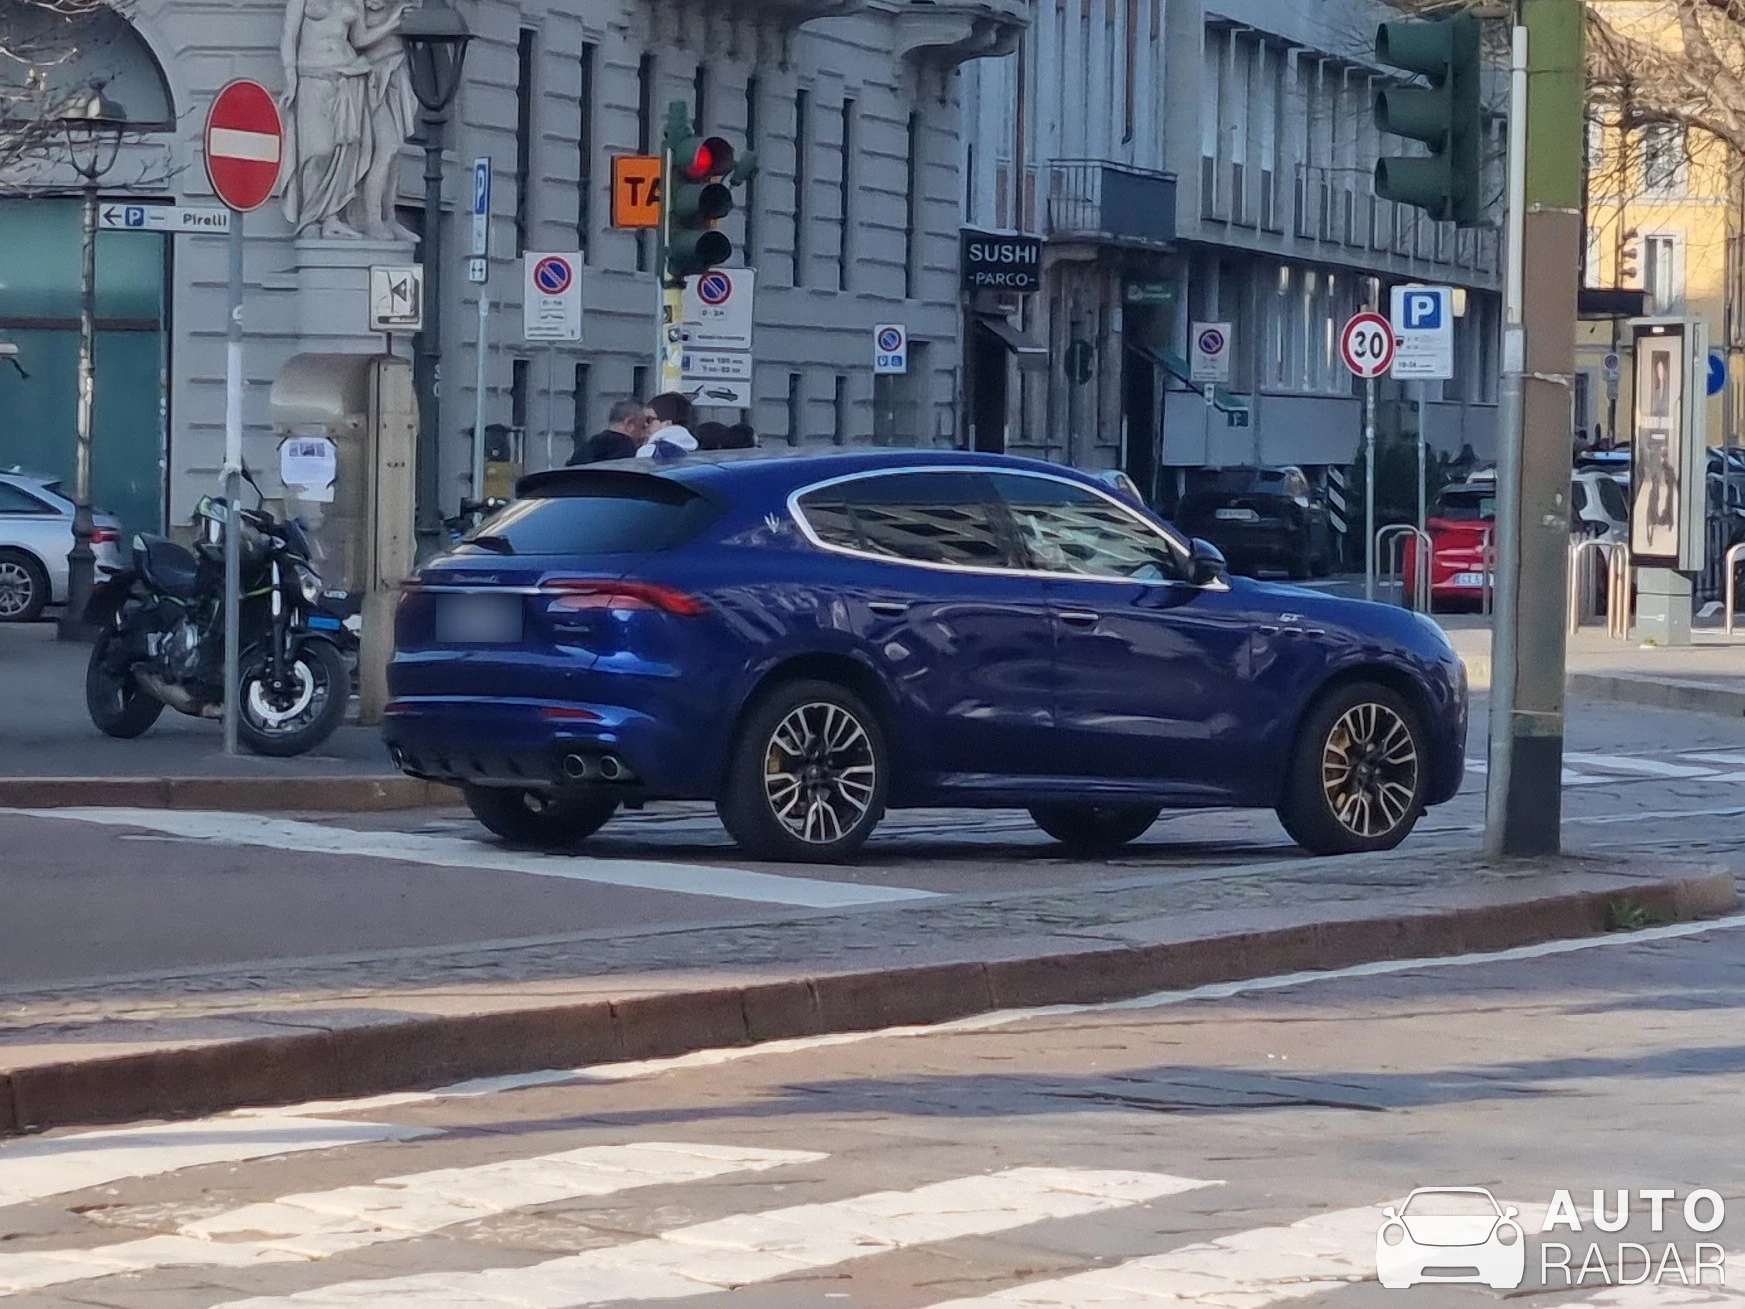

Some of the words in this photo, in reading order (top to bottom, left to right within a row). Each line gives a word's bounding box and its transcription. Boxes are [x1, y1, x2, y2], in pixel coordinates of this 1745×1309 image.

[128, 209, 141, 225] P
[969, 244, 1037, 263] SUSHI
[1411, 295, 1434, 326] P
[1354, 331, 1384, 359] 30
